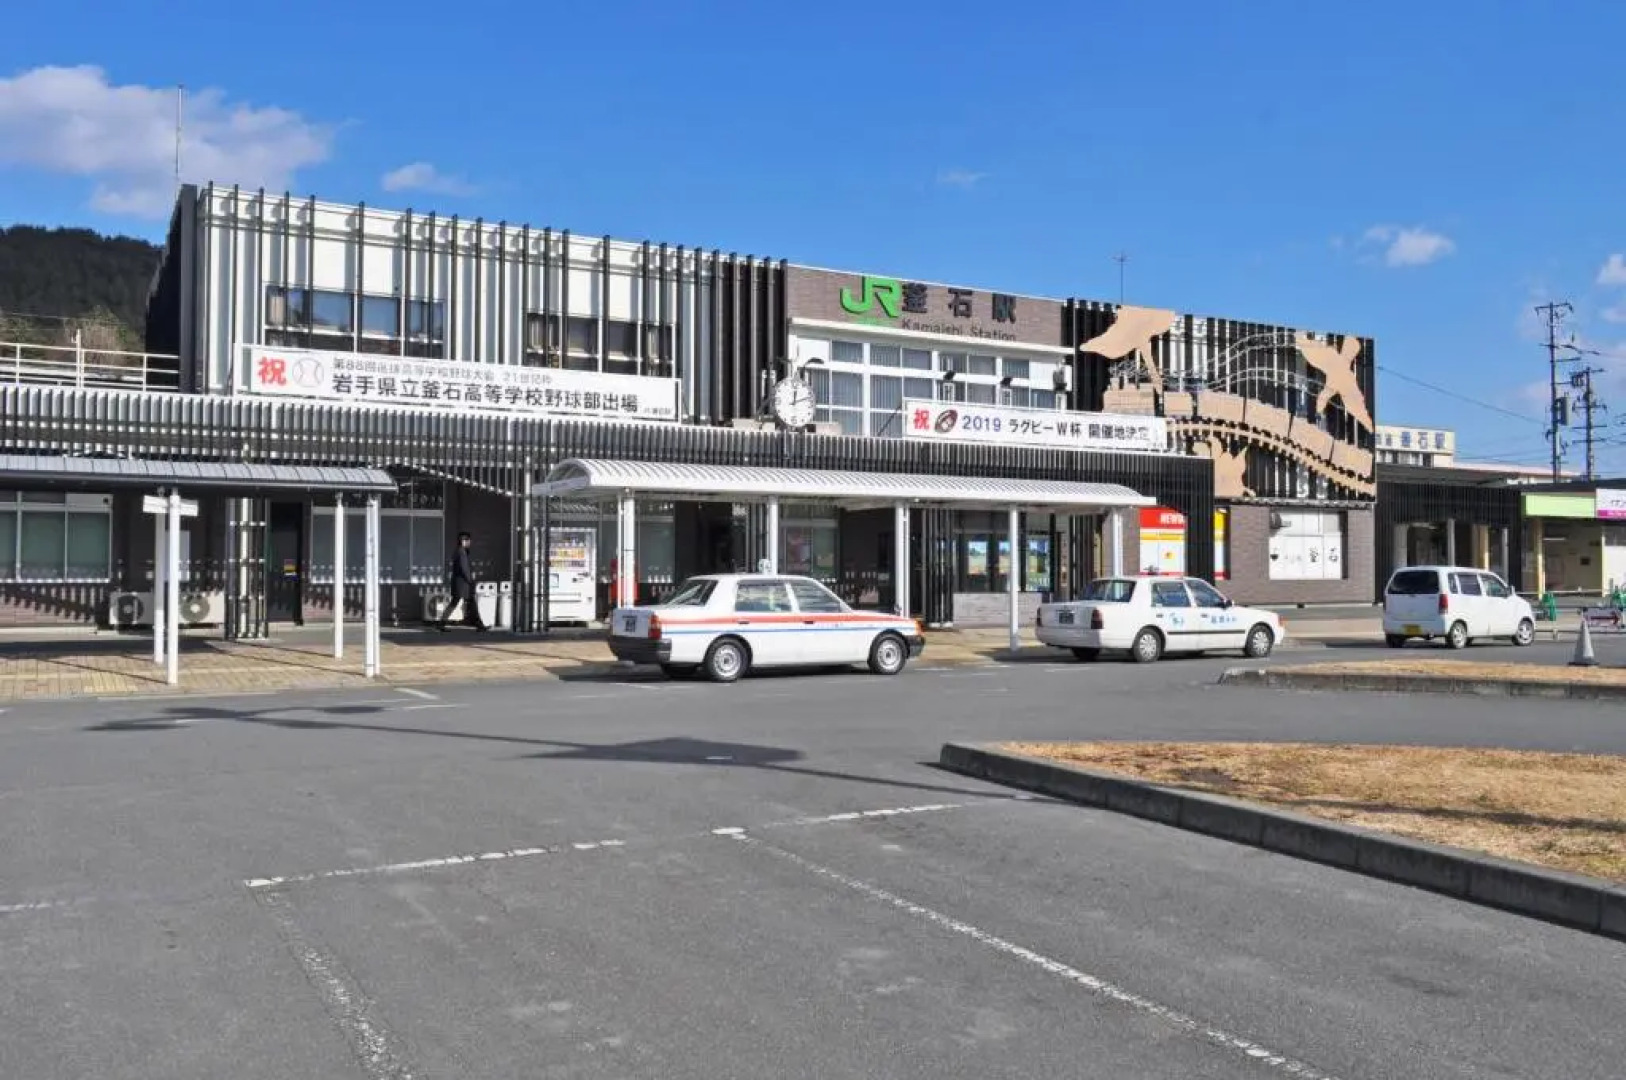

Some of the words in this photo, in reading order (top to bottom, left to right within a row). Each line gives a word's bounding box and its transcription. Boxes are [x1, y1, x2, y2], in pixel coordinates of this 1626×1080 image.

[840, 276, 900, 318] JR
[901, 282, 1017, 324] 釜石駅
[901, 318, 963, 336] Kamaishi
[969, 325, 1017, 342] Station
[257, 356, 287, 386] 祝
[332, 373, 638, 413] 岩手県立釜石高等学校野球部出場
[913, 408, 930, 430] 祝
[961, 415, 1002, 432] 2019
[1008, 418, 1083, 439] ラグビーW杯
